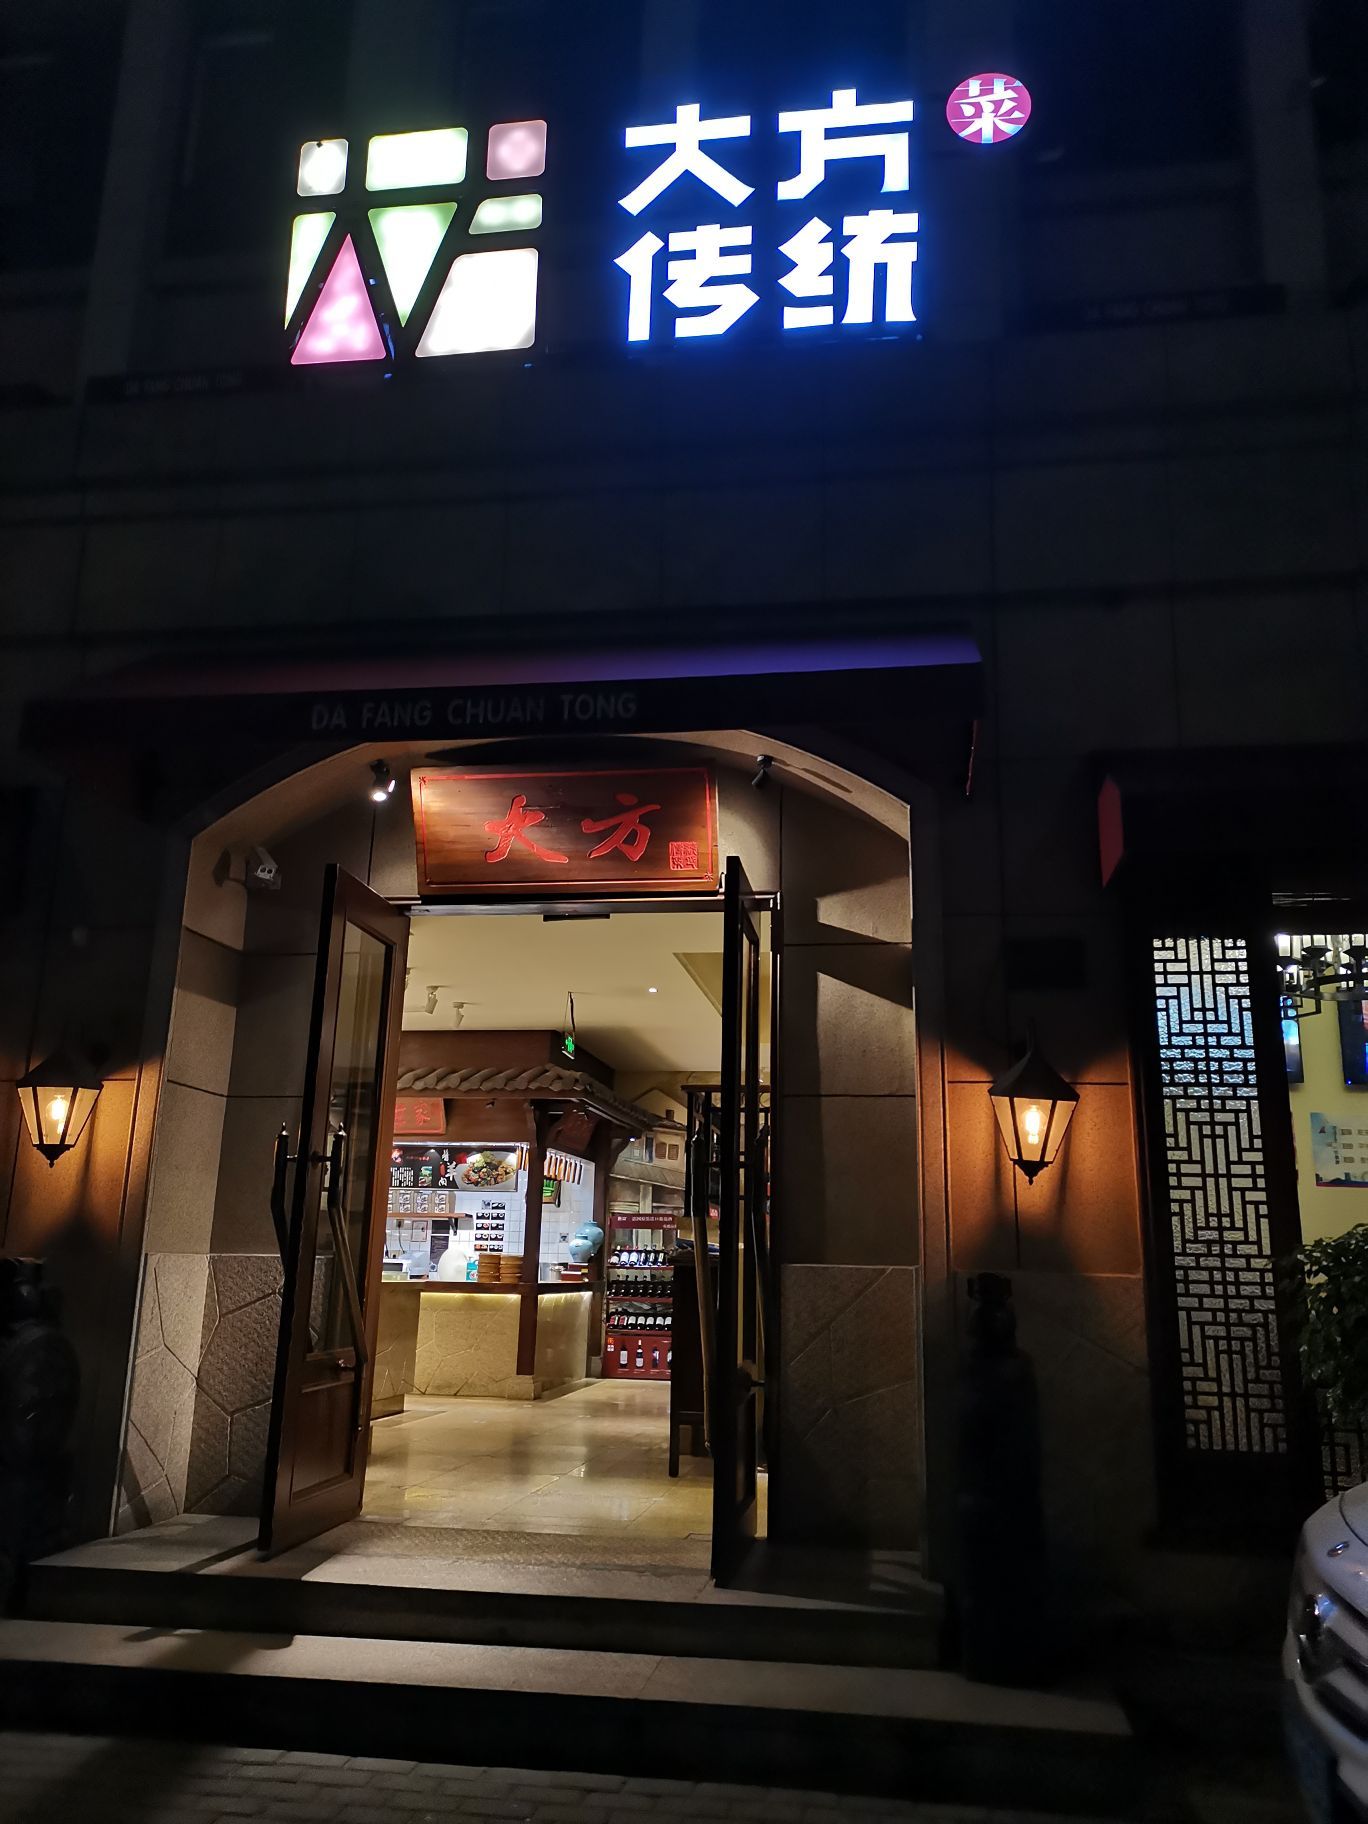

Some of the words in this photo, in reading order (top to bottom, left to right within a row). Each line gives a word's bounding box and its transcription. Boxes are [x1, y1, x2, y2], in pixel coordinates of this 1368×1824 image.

[950, 78, 1026, 144] 菜
[617, 88, 914, 217] 大方
[613, 209, 919, 342] 传统
[311, 703, 348, 731] DA
[360, 700, 433, 729] FANG
[447, 695, 546, 726] CHUAN
[559, 692, 638, 721] TONG
[484, 793, 663, 864] 大方
